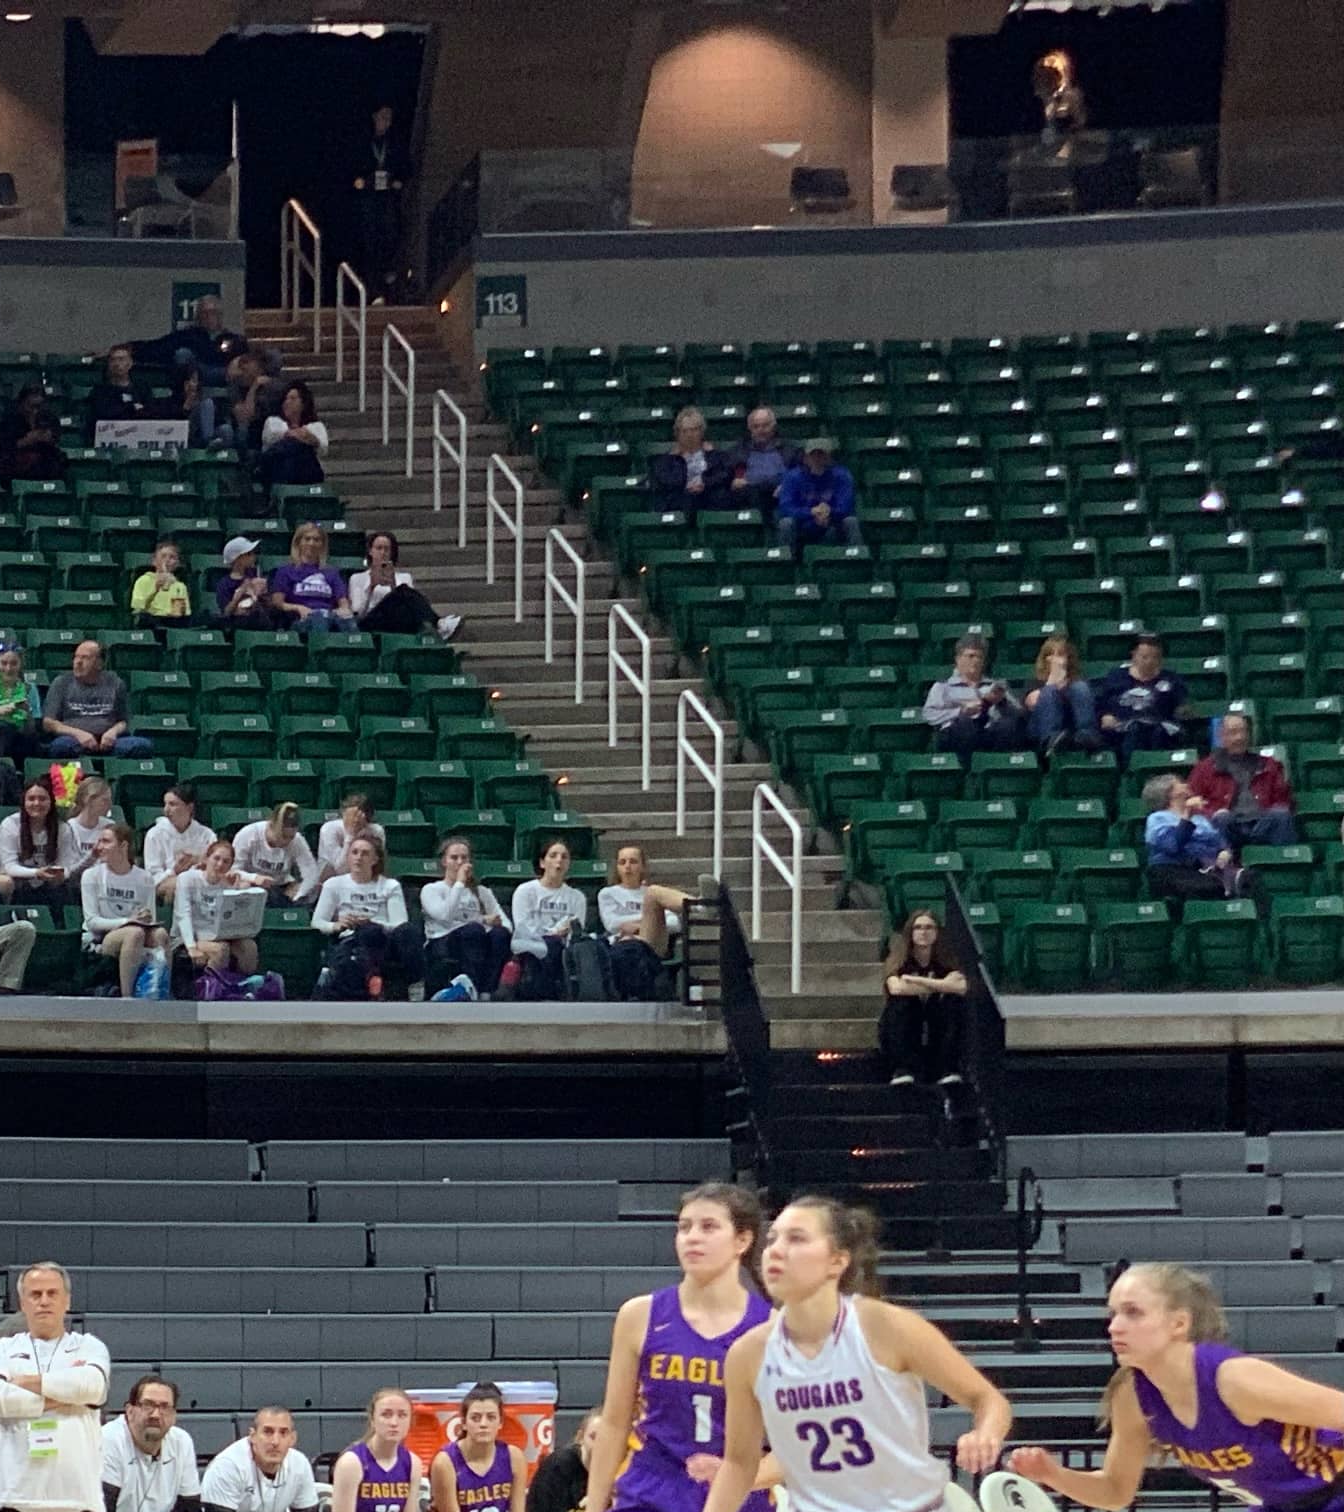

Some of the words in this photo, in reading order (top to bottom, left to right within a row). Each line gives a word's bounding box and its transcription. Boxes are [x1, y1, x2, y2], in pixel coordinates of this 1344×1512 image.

[180, 300, 200, 320] 11
[485, 293, 518, 316] 113
[649, 1354, 724, 1386] EAGL
[774, 1378, 864, 1413] COUGARS
[537, 1417, 555, 1446] G
[692, 1394, 713, 1444] 1
[795, 1416, 876, 1474] 23
